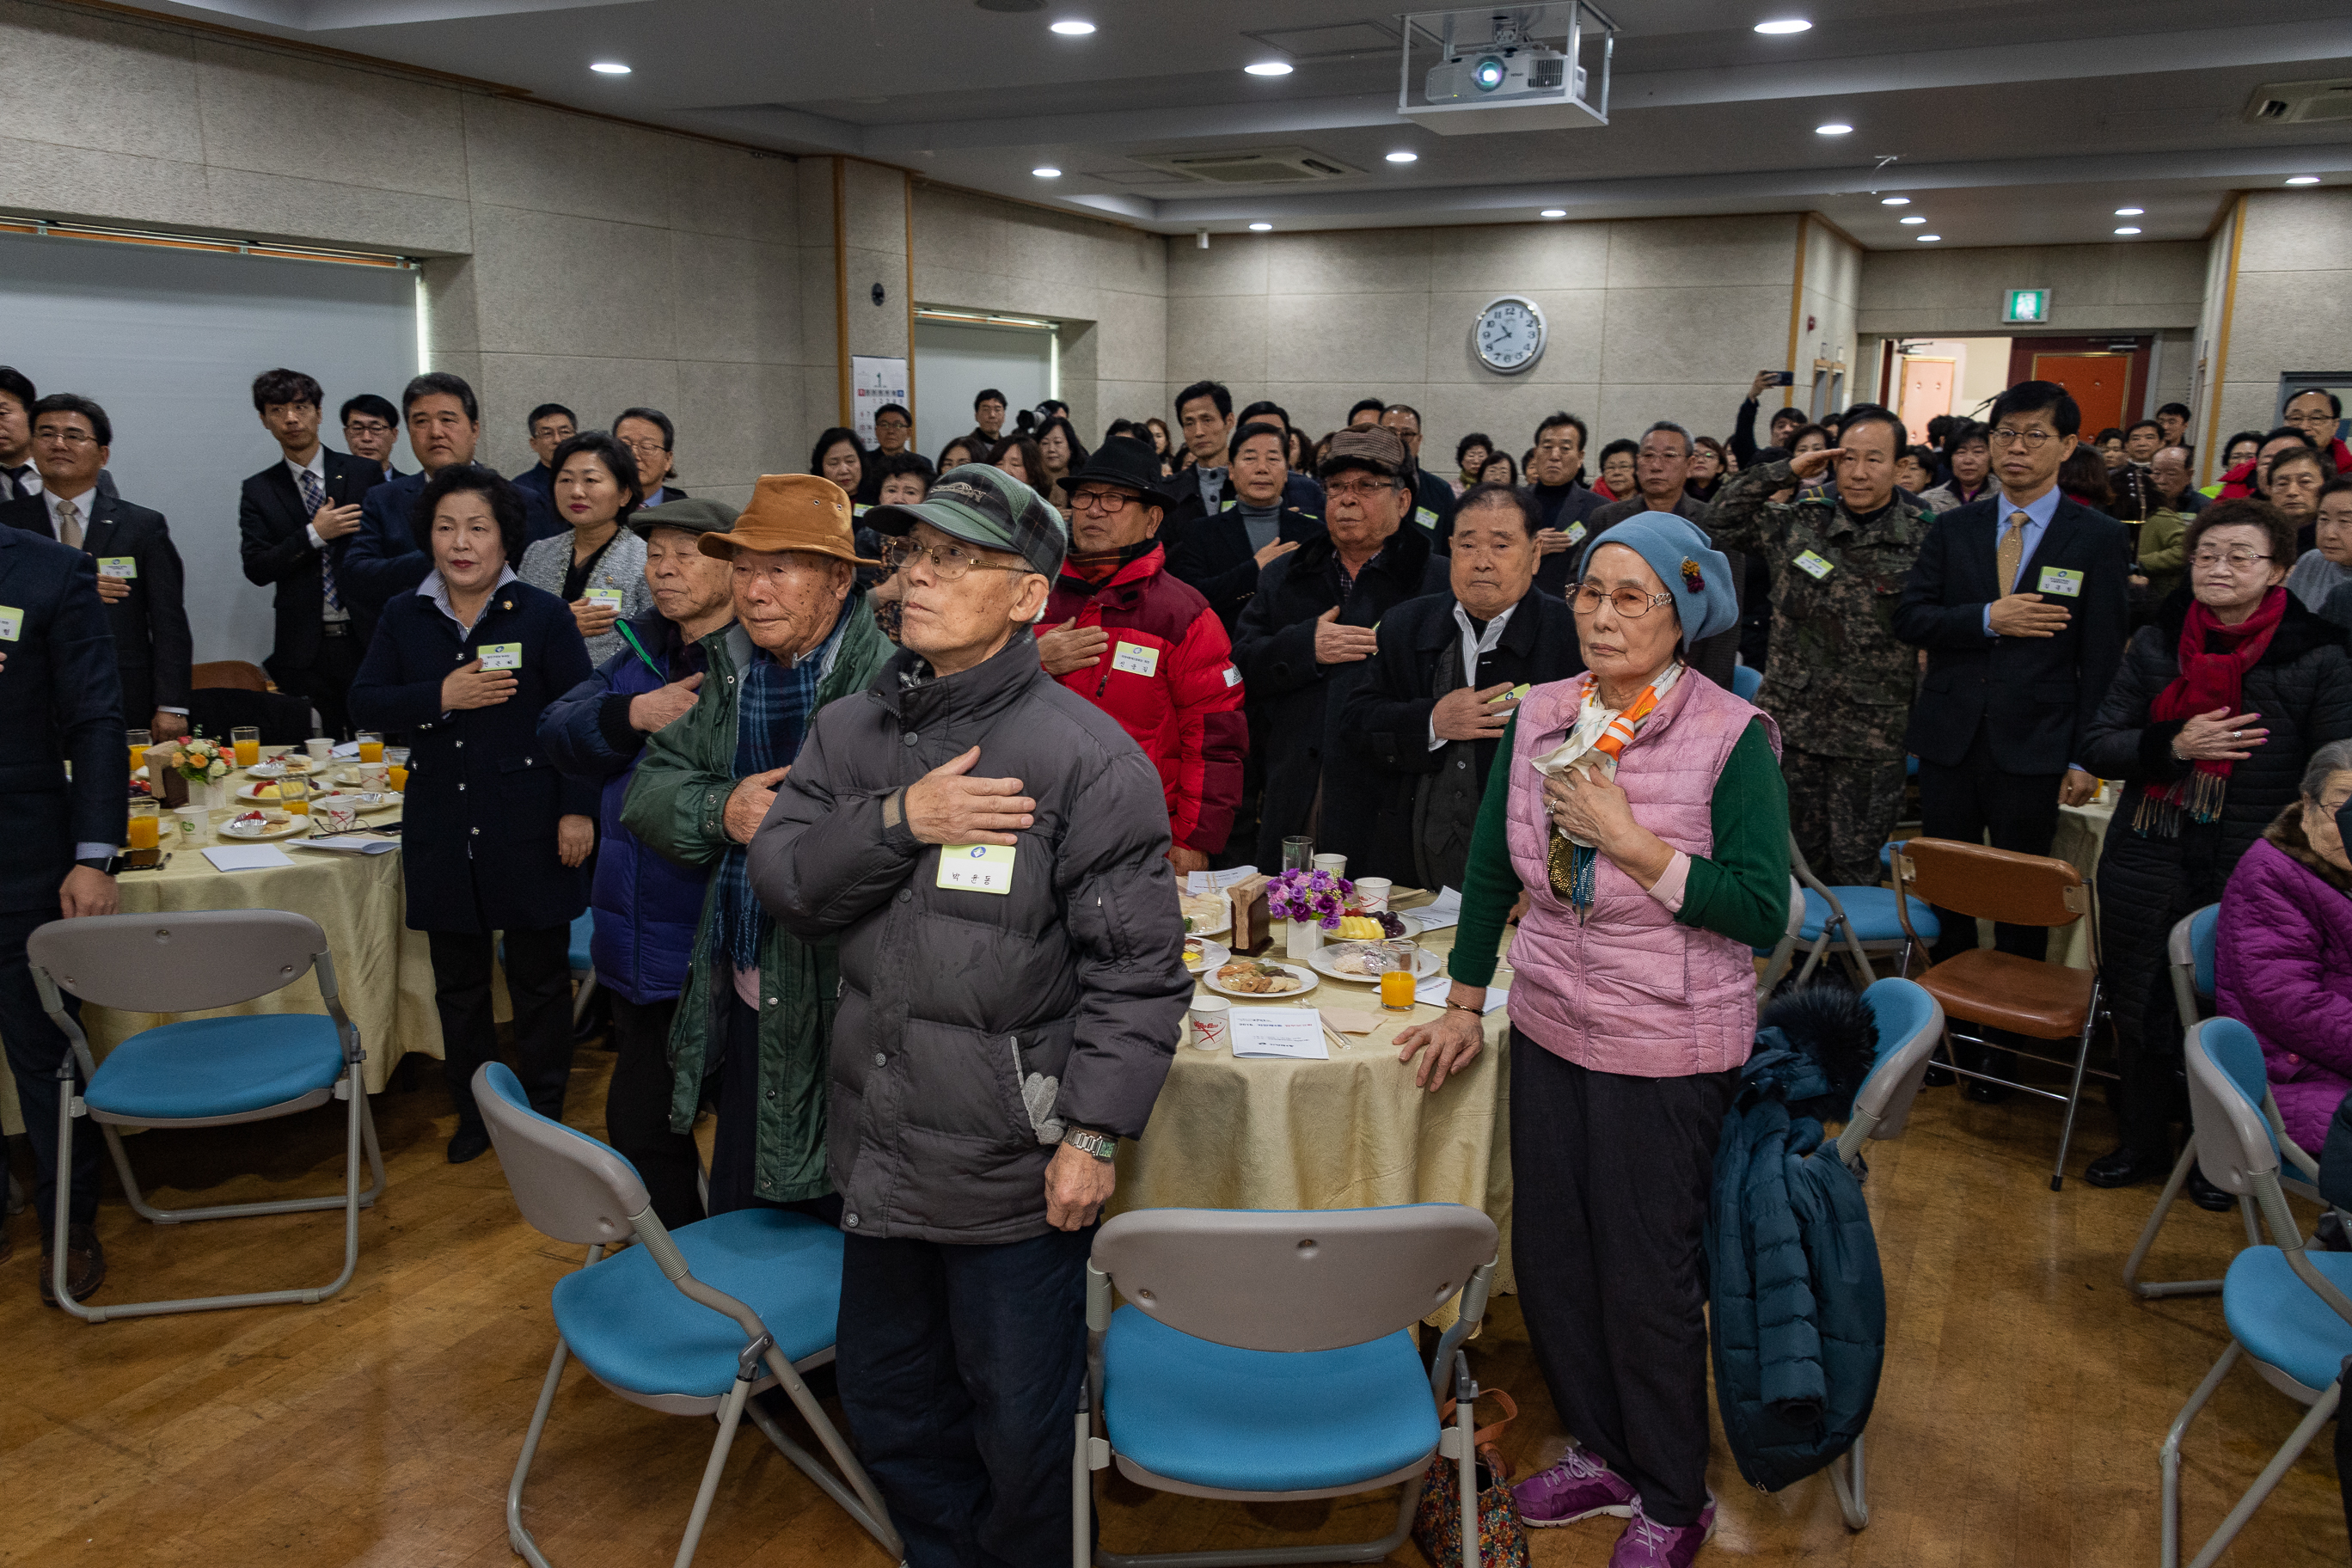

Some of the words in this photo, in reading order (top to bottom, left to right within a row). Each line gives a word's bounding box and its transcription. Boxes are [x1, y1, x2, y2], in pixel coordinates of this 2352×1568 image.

[1486, 320, 1495, 328] 10
[1482, 331, 1491, 340] 9
[1528, 330, 1535, 340] 3
[1485, 343, 1493, 352] 8
[1504, 354, 1511, 363] 6
[952, 873, 960, 881] 박
